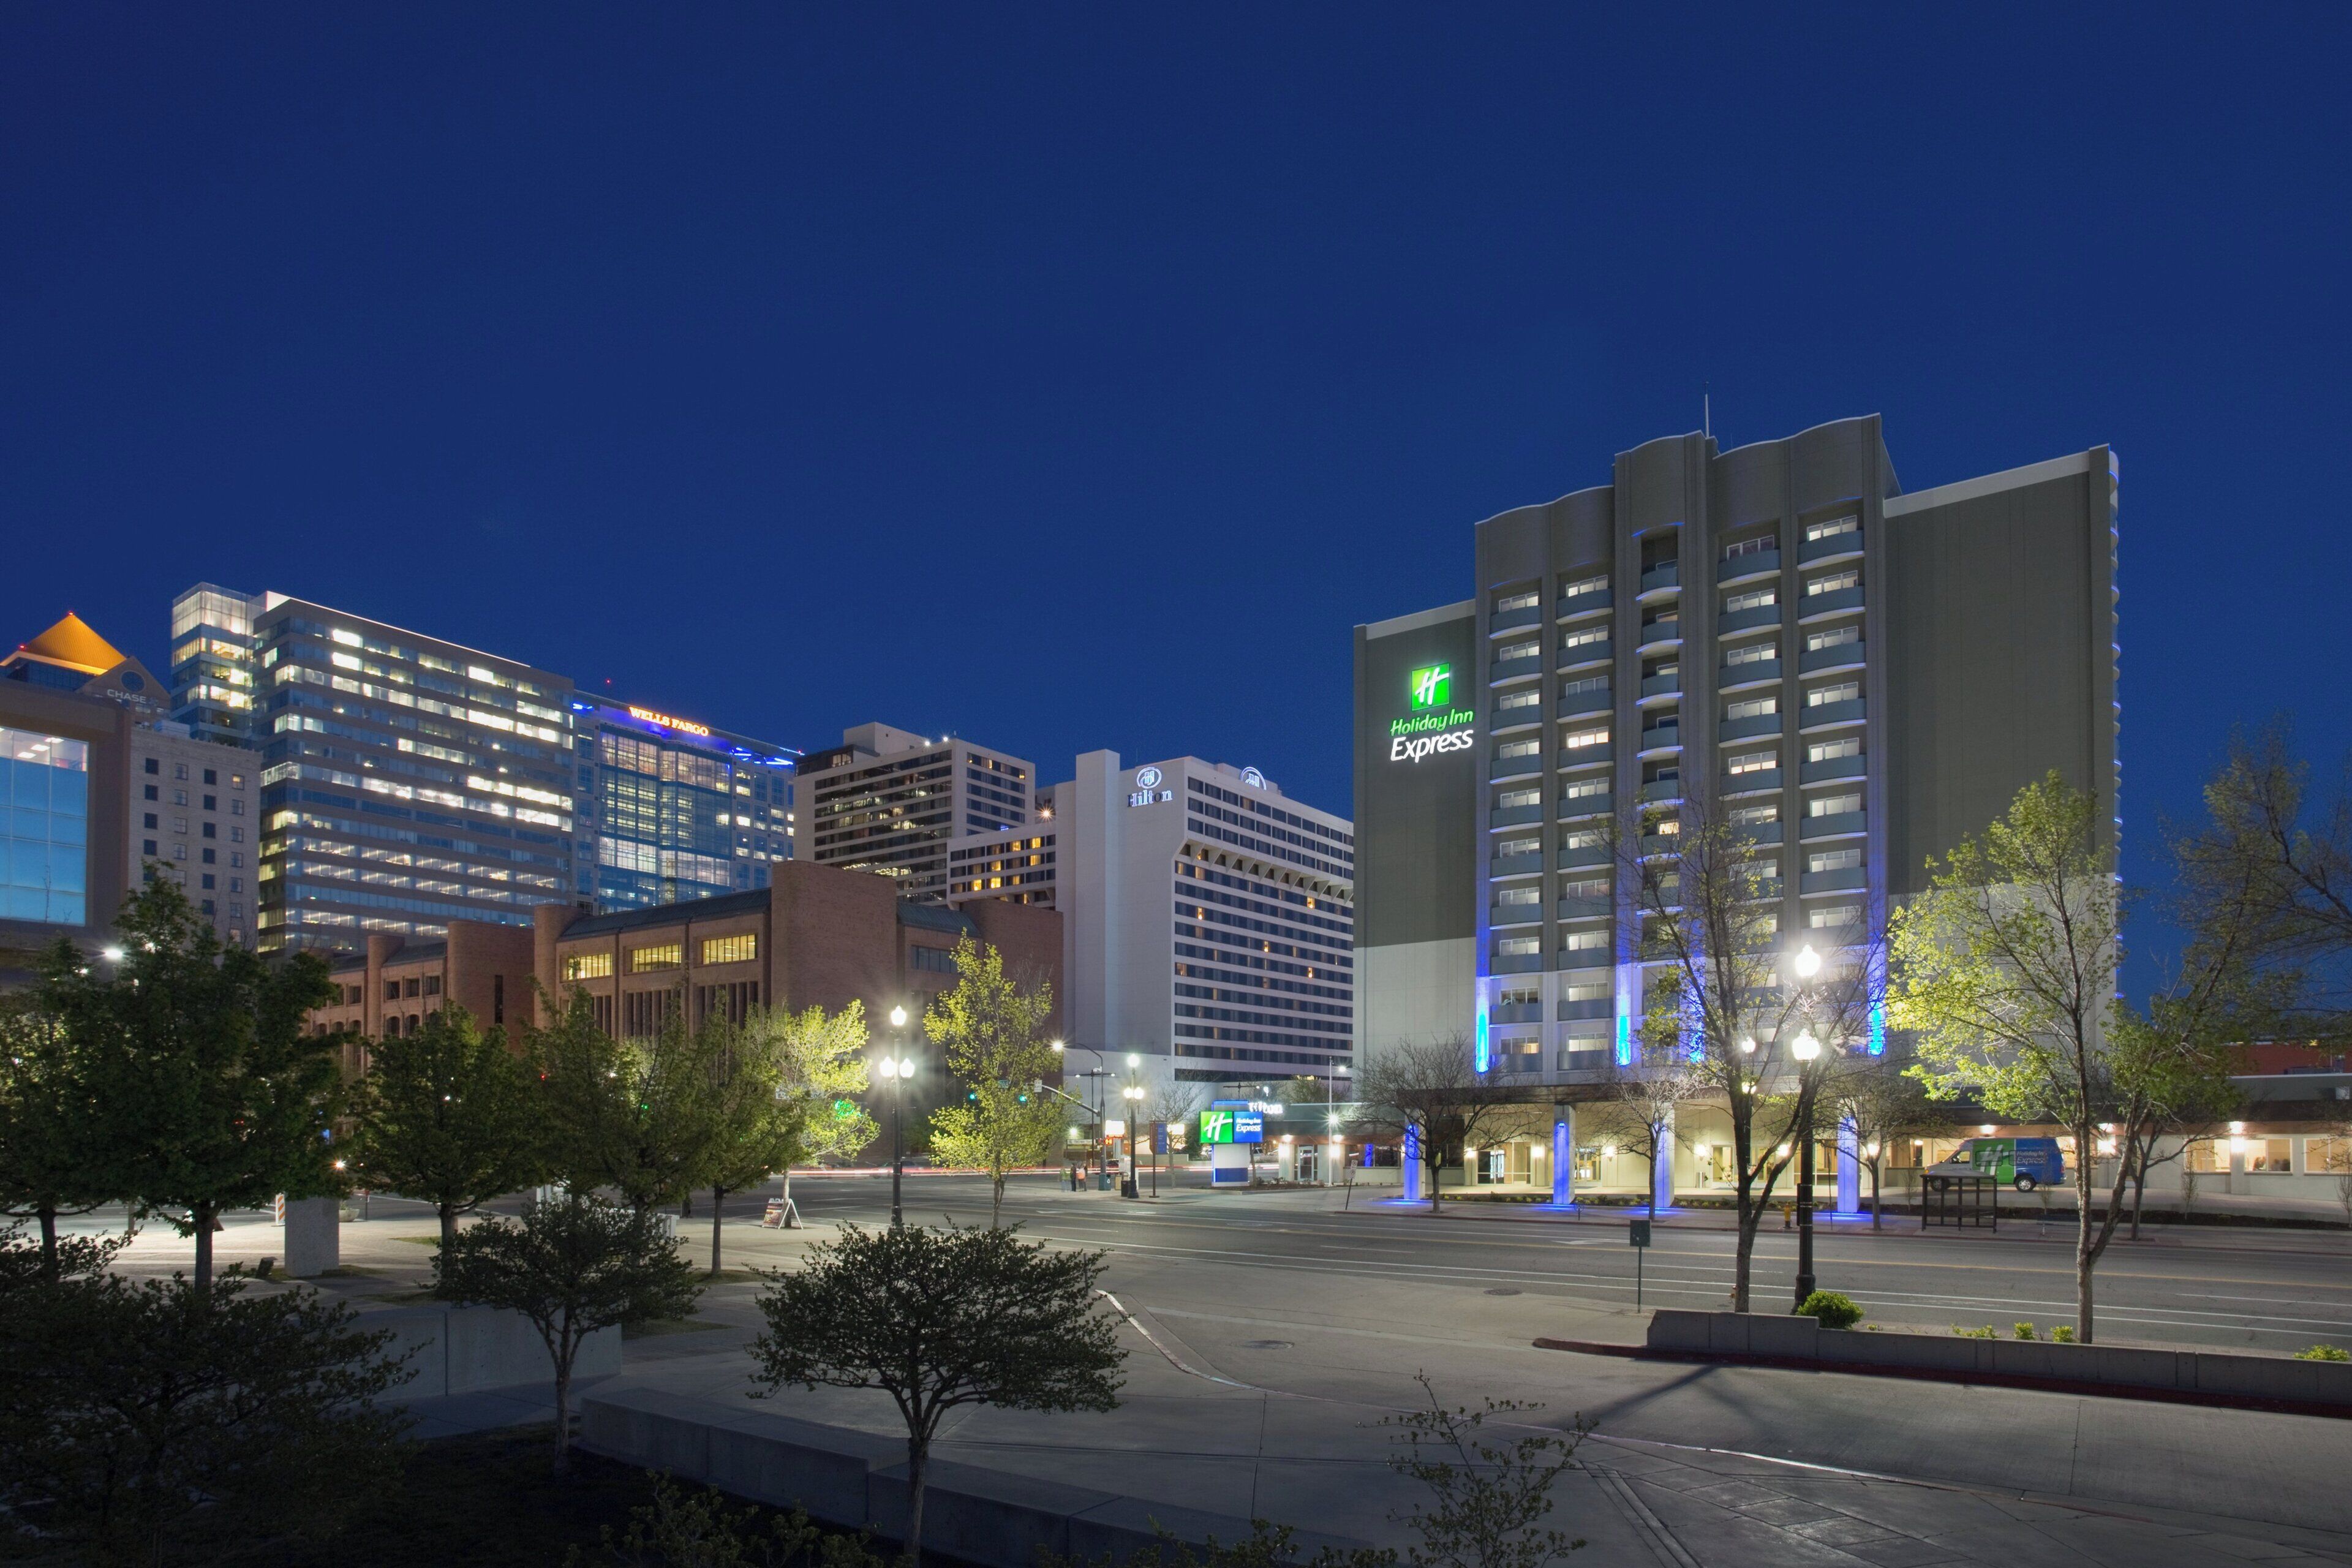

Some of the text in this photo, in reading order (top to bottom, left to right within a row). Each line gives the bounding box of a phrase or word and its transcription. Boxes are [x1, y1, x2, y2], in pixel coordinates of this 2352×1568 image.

[107, 689, 147, 704] CHASE
[628, 706, 709, 737] WELLS FARGO
[1390, 708, 1474, 736] Holiday Inn
[1390, 729, 1474, 763] Express
[1127, 789, 1173, 808] Hilton
